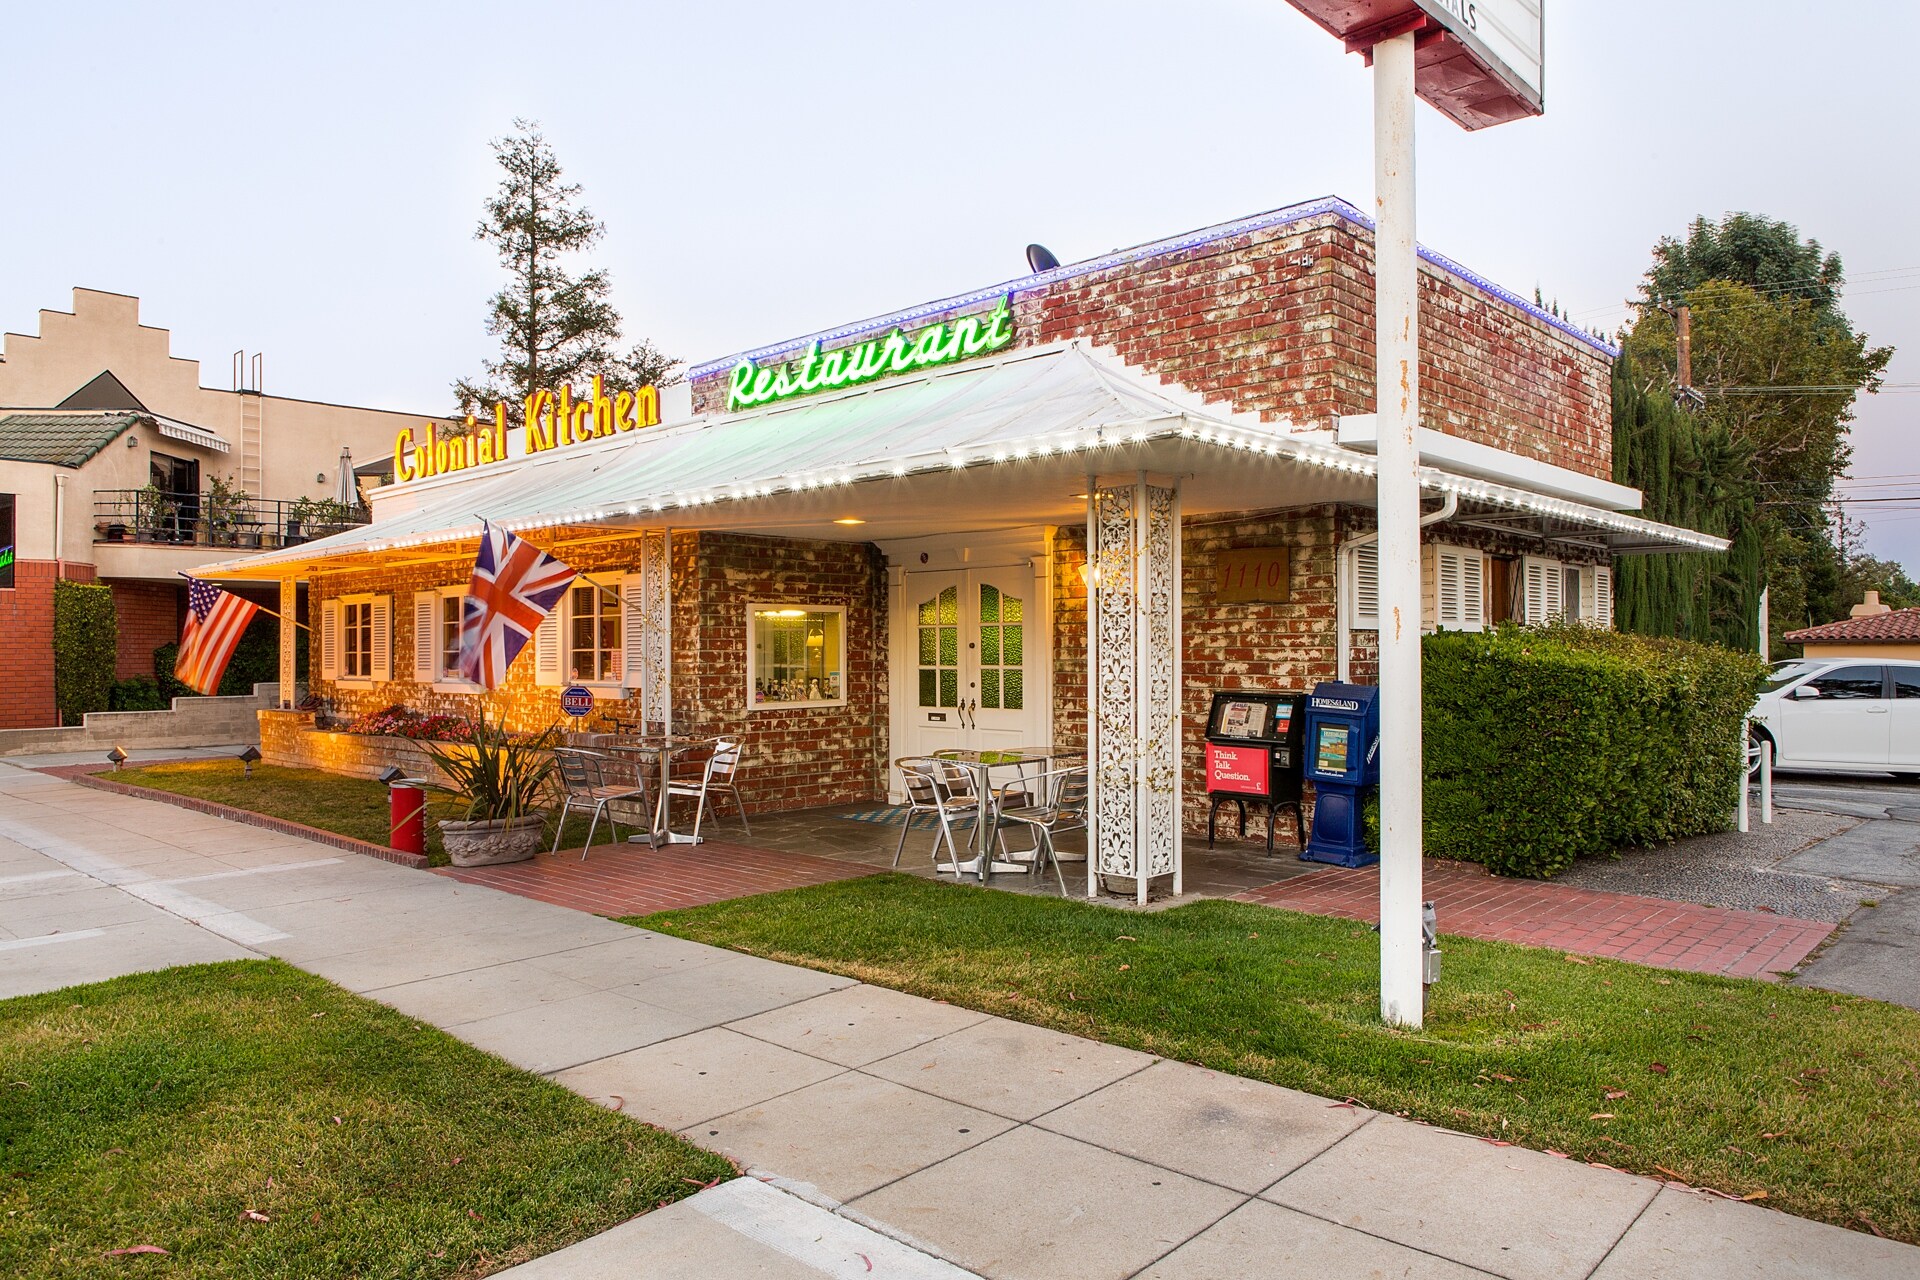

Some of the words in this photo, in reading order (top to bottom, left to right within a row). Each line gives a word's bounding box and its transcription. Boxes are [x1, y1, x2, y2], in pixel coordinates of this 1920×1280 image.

[727, 291, 1017, 412] Restaurant
[394, 400, 508, 482] Colonial
[524, 373, 662, 455] Kitchen
[1224, 561, 1281, 589] 1110
[565, 697, 592, 707] BELL
[1214, 750, 1238, 760] Think.
[1214, 760, 1232, 769] Talk.
[1214, 769, 1251, 781] Question.
